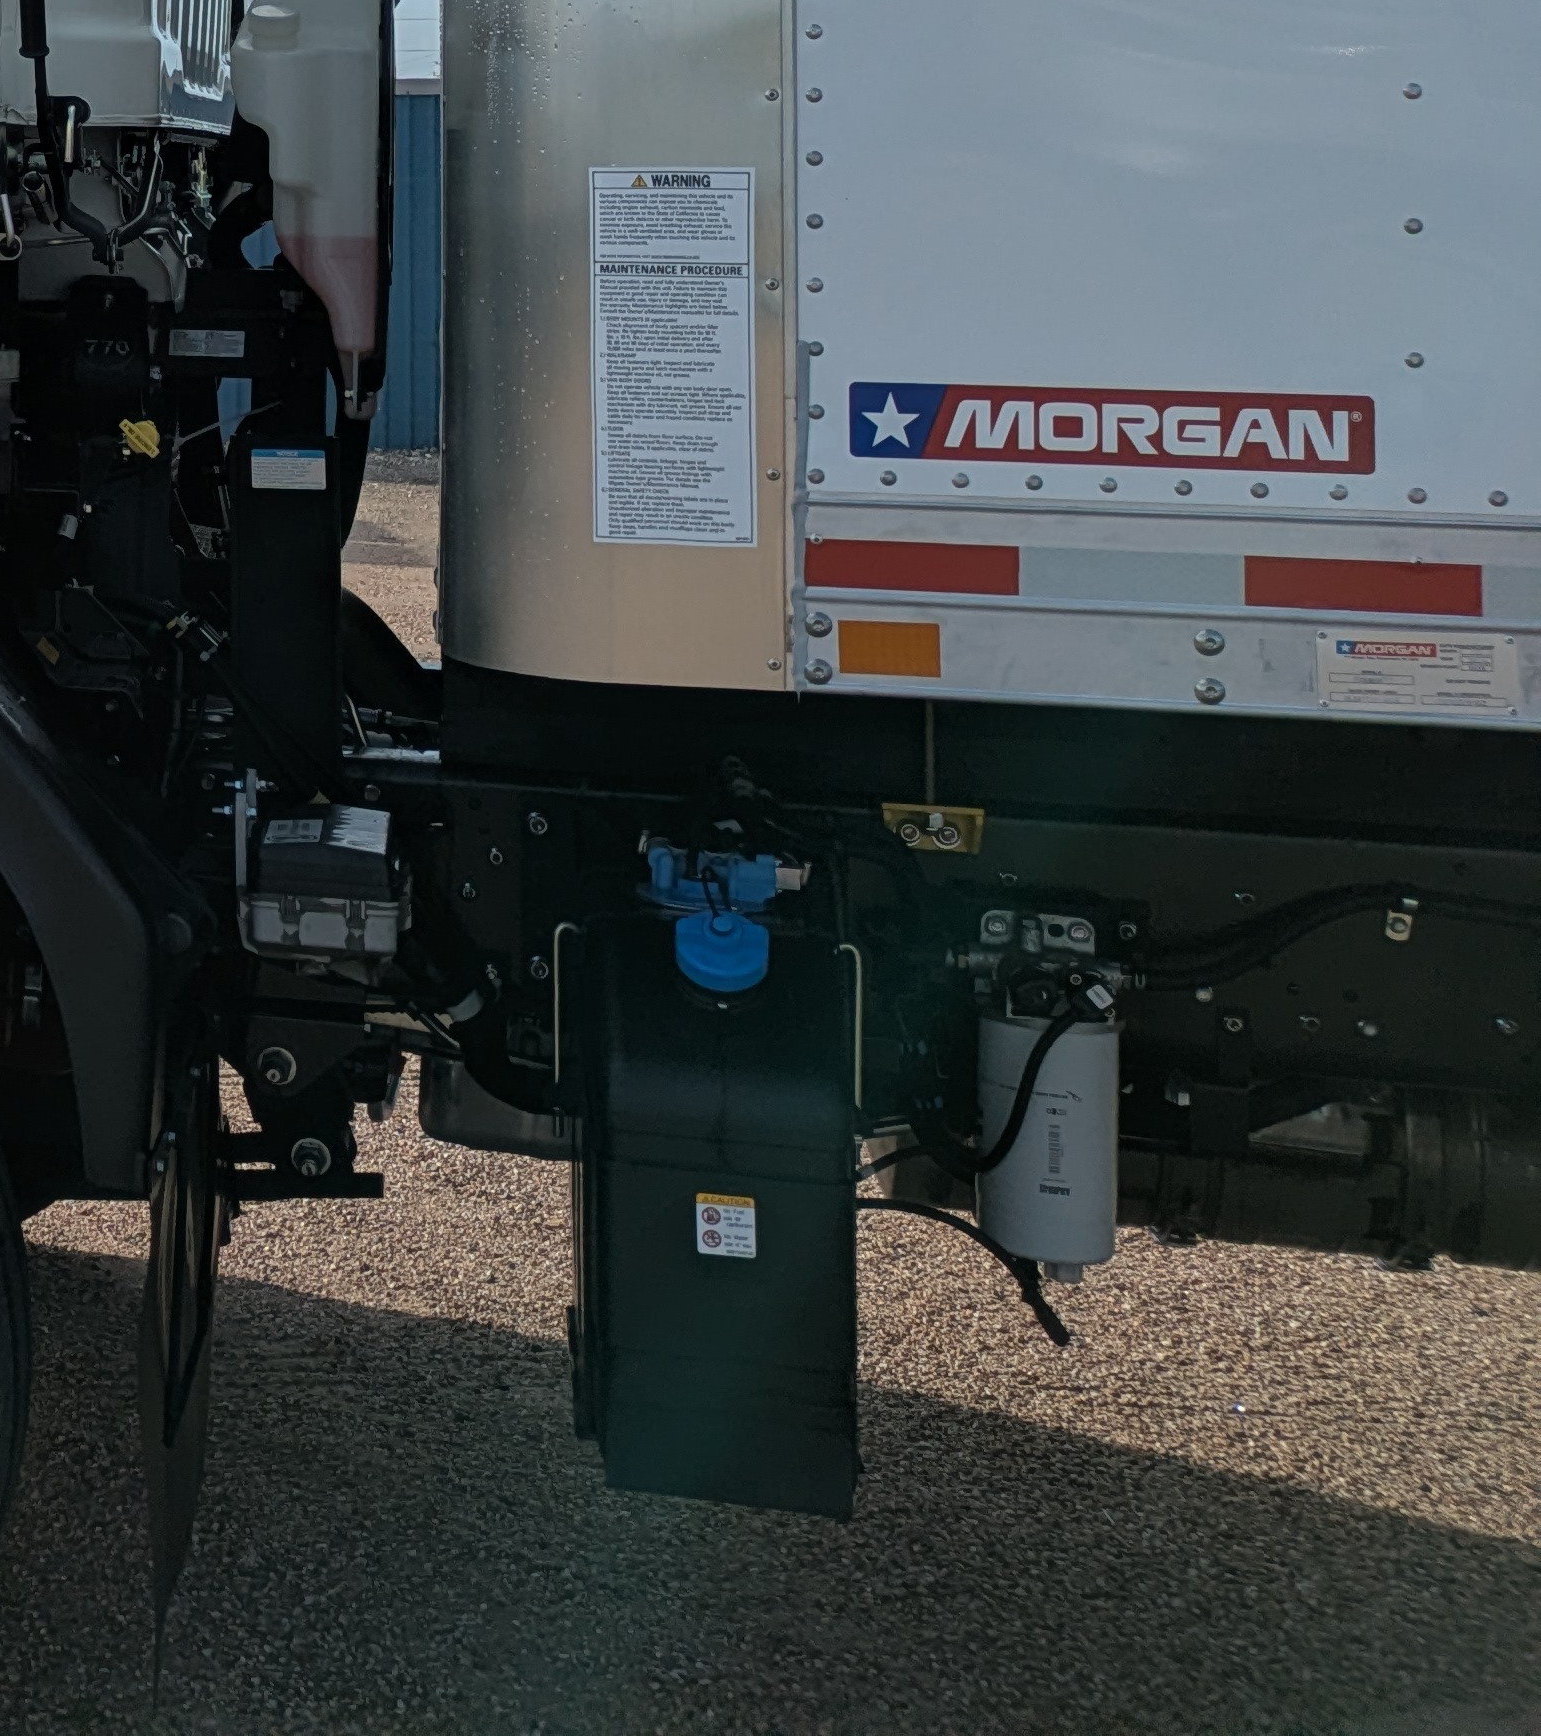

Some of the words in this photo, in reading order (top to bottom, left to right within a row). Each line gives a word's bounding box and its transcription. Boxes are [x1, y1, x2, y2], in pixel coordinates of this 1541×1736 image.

[650, 174, 711, 188] WARNING
[599, 264, 677, 275] MAINTENANCE
[680, 266, 743, 277] PROCEDURE
[943, 399, 1350, 462] MORGAN
[1354, 643, 1432, 657] MORGAN
[710, 1195, 751, 1205] CAUTION
